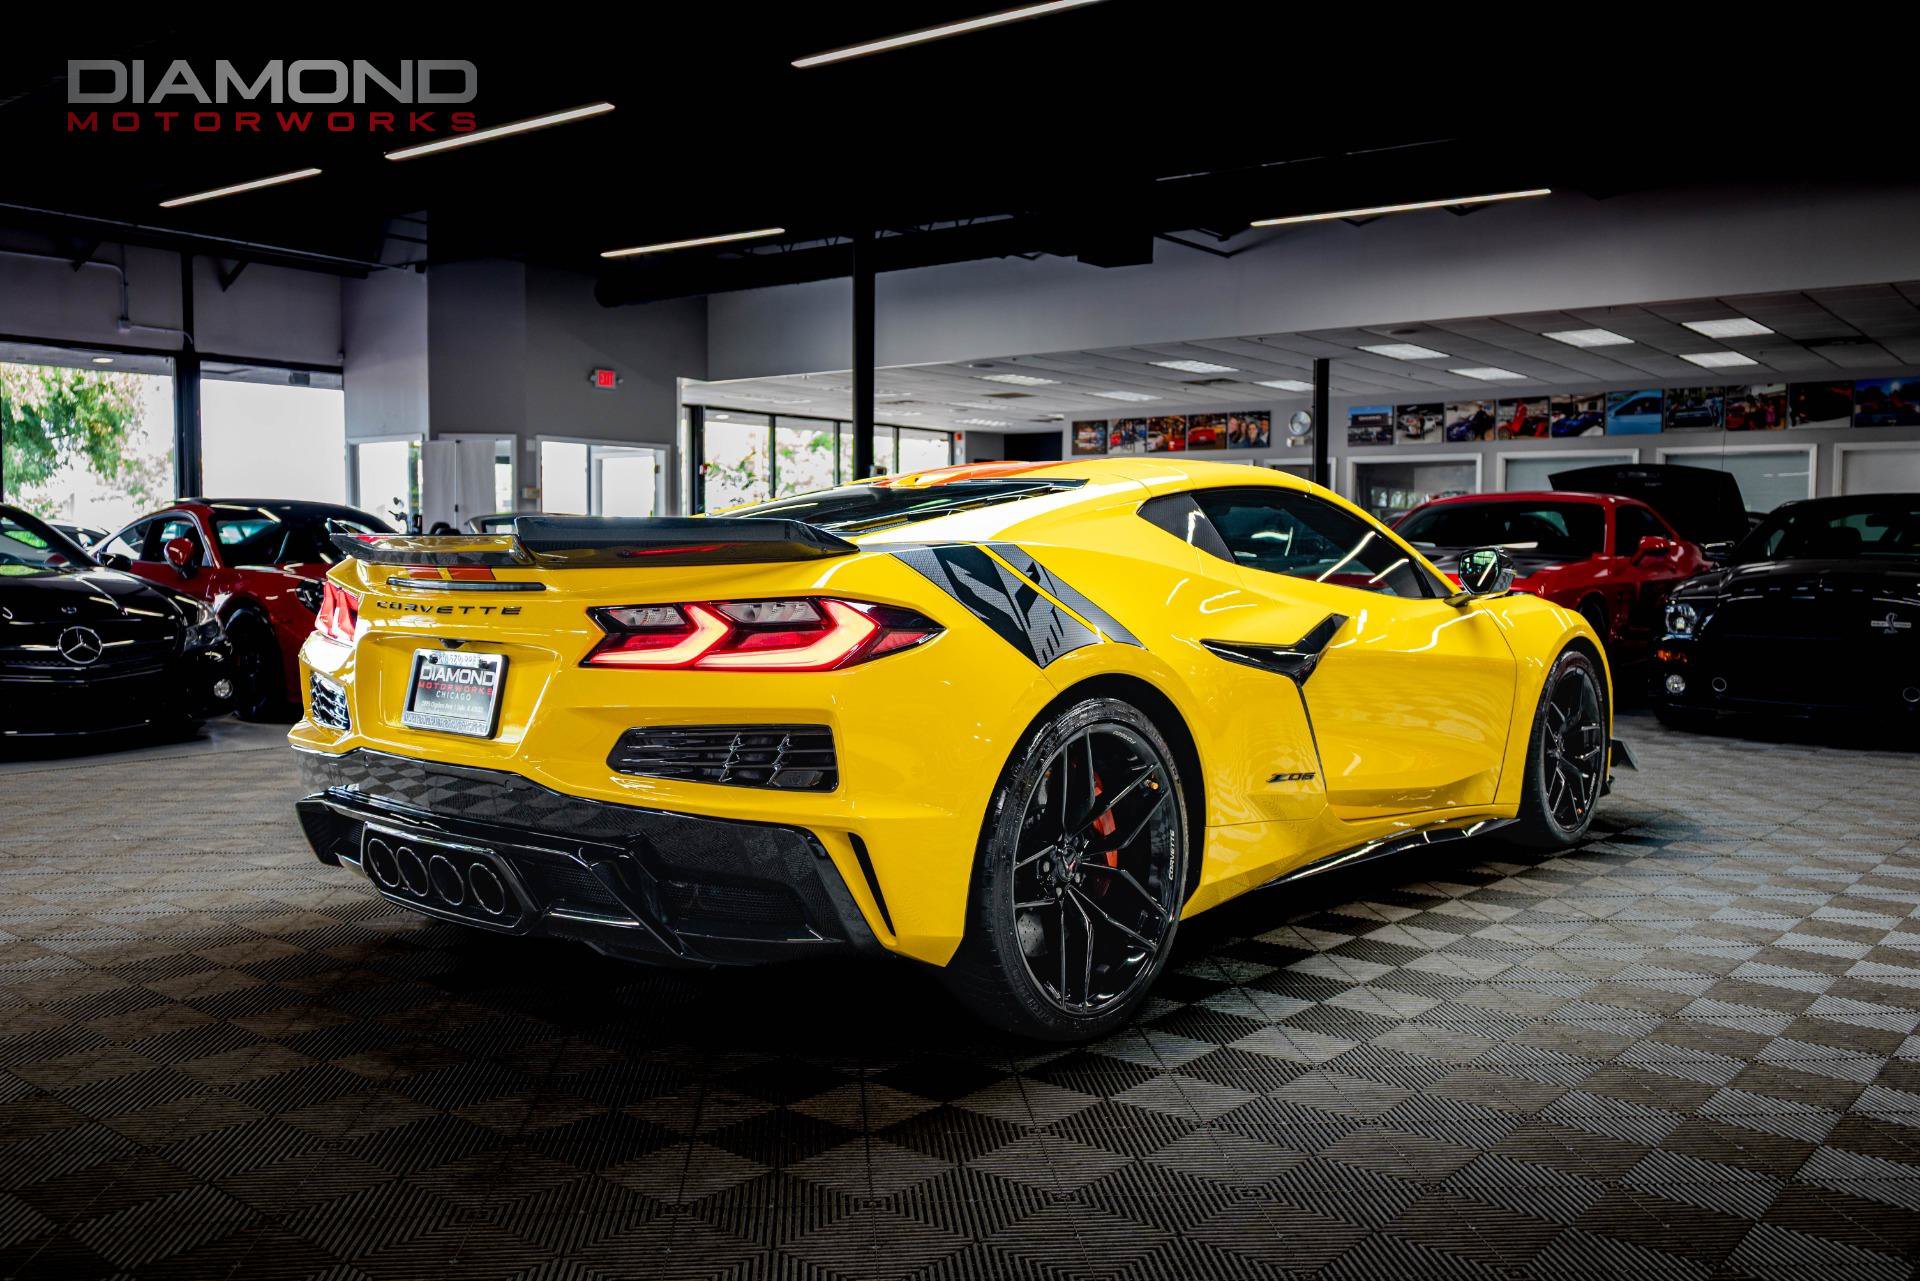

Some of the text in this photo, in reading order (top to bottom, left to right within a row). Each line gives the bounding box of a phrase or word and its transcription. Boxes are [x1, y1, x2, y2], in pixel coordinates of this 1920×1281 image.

[377, 601, 522, 615] CORVETTE
[420, 665, 496, 687] DIAMOND
[436, 690, 472, 701] CHICAGO
[1265, 772, 1316, 783] Z06
